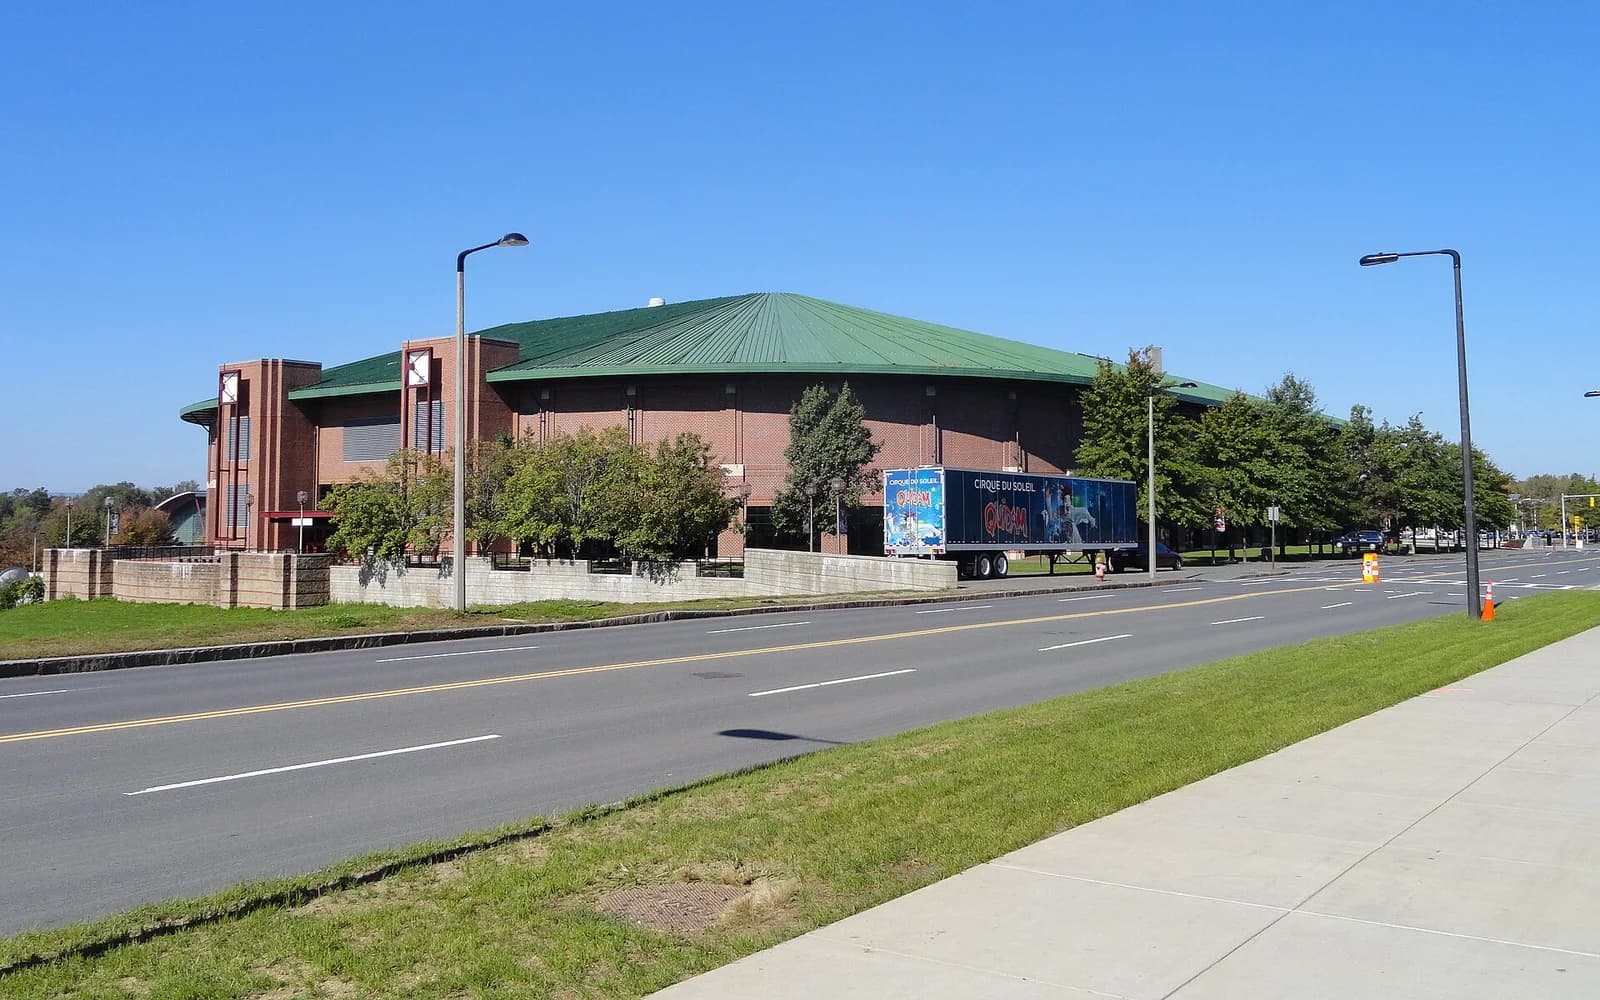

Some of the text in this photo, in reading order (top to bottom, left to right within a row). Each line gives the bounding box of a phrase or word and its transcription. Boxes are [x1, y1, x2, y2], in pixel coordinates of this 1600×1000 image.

[974, 479, 1037, 493] CIRQUE DU SOLEIL
